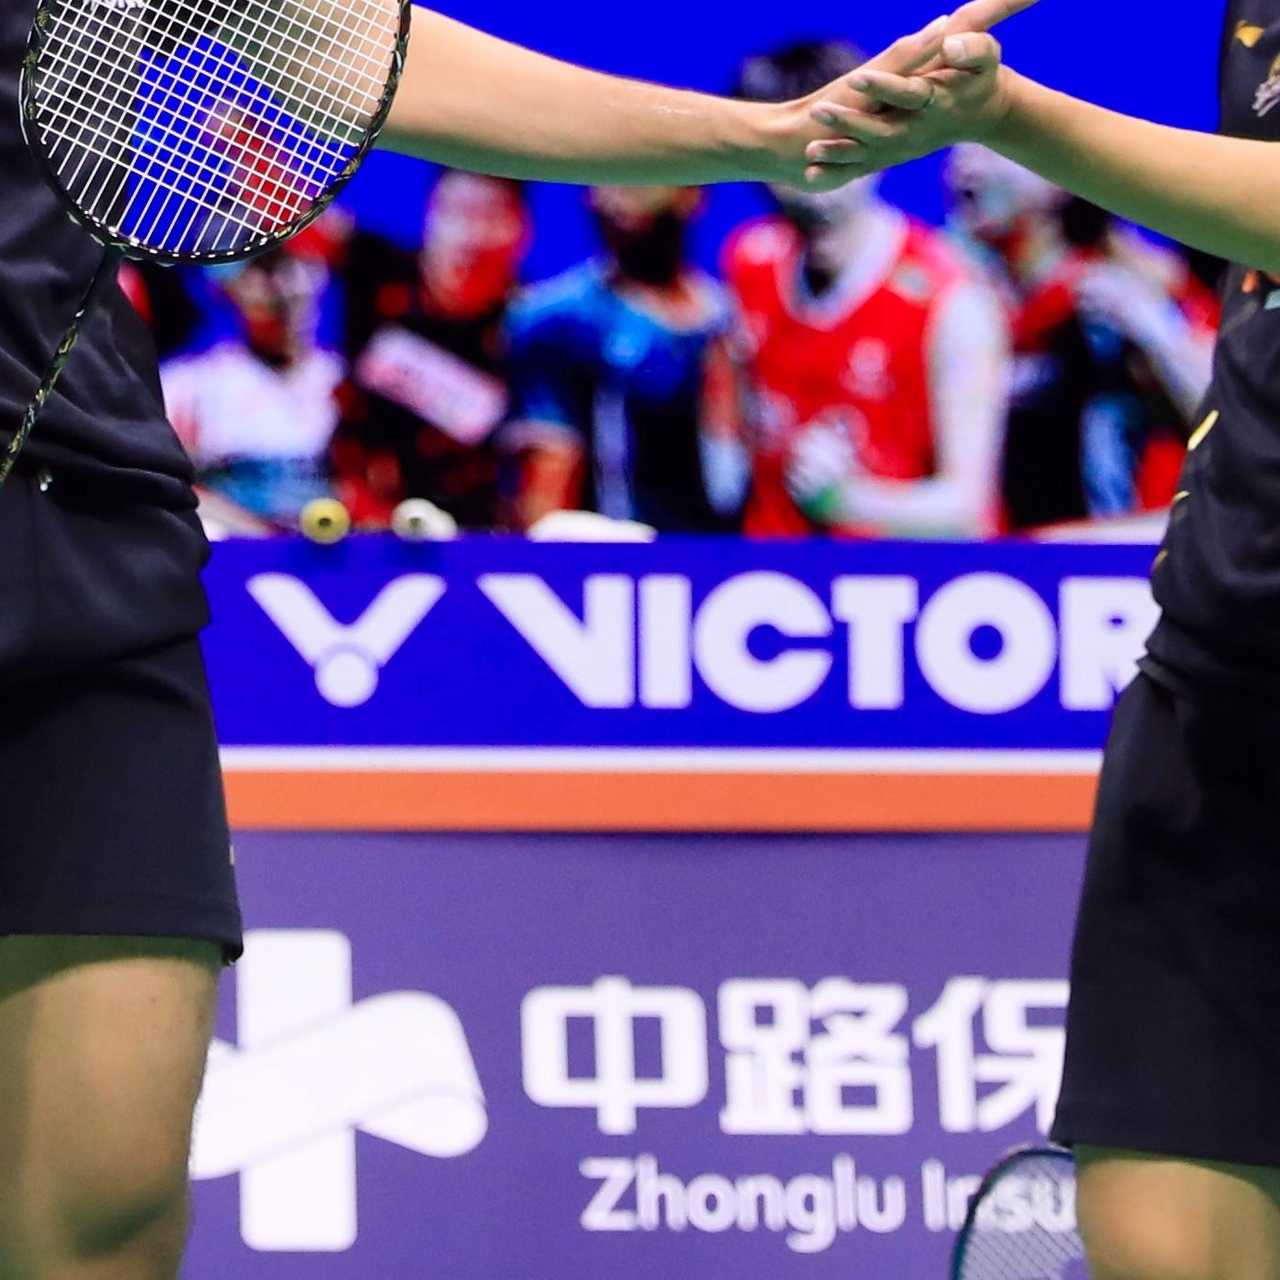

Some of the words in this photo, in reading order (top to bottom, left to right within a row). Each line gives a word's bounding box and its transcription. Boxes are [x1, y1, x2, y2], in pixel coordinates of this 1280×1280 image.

[476, 570, 1162, 714] VICTOR
[521, 974, 1070, 1136] 中路保
[579, 1152, 906, 1253] Zhonglu
